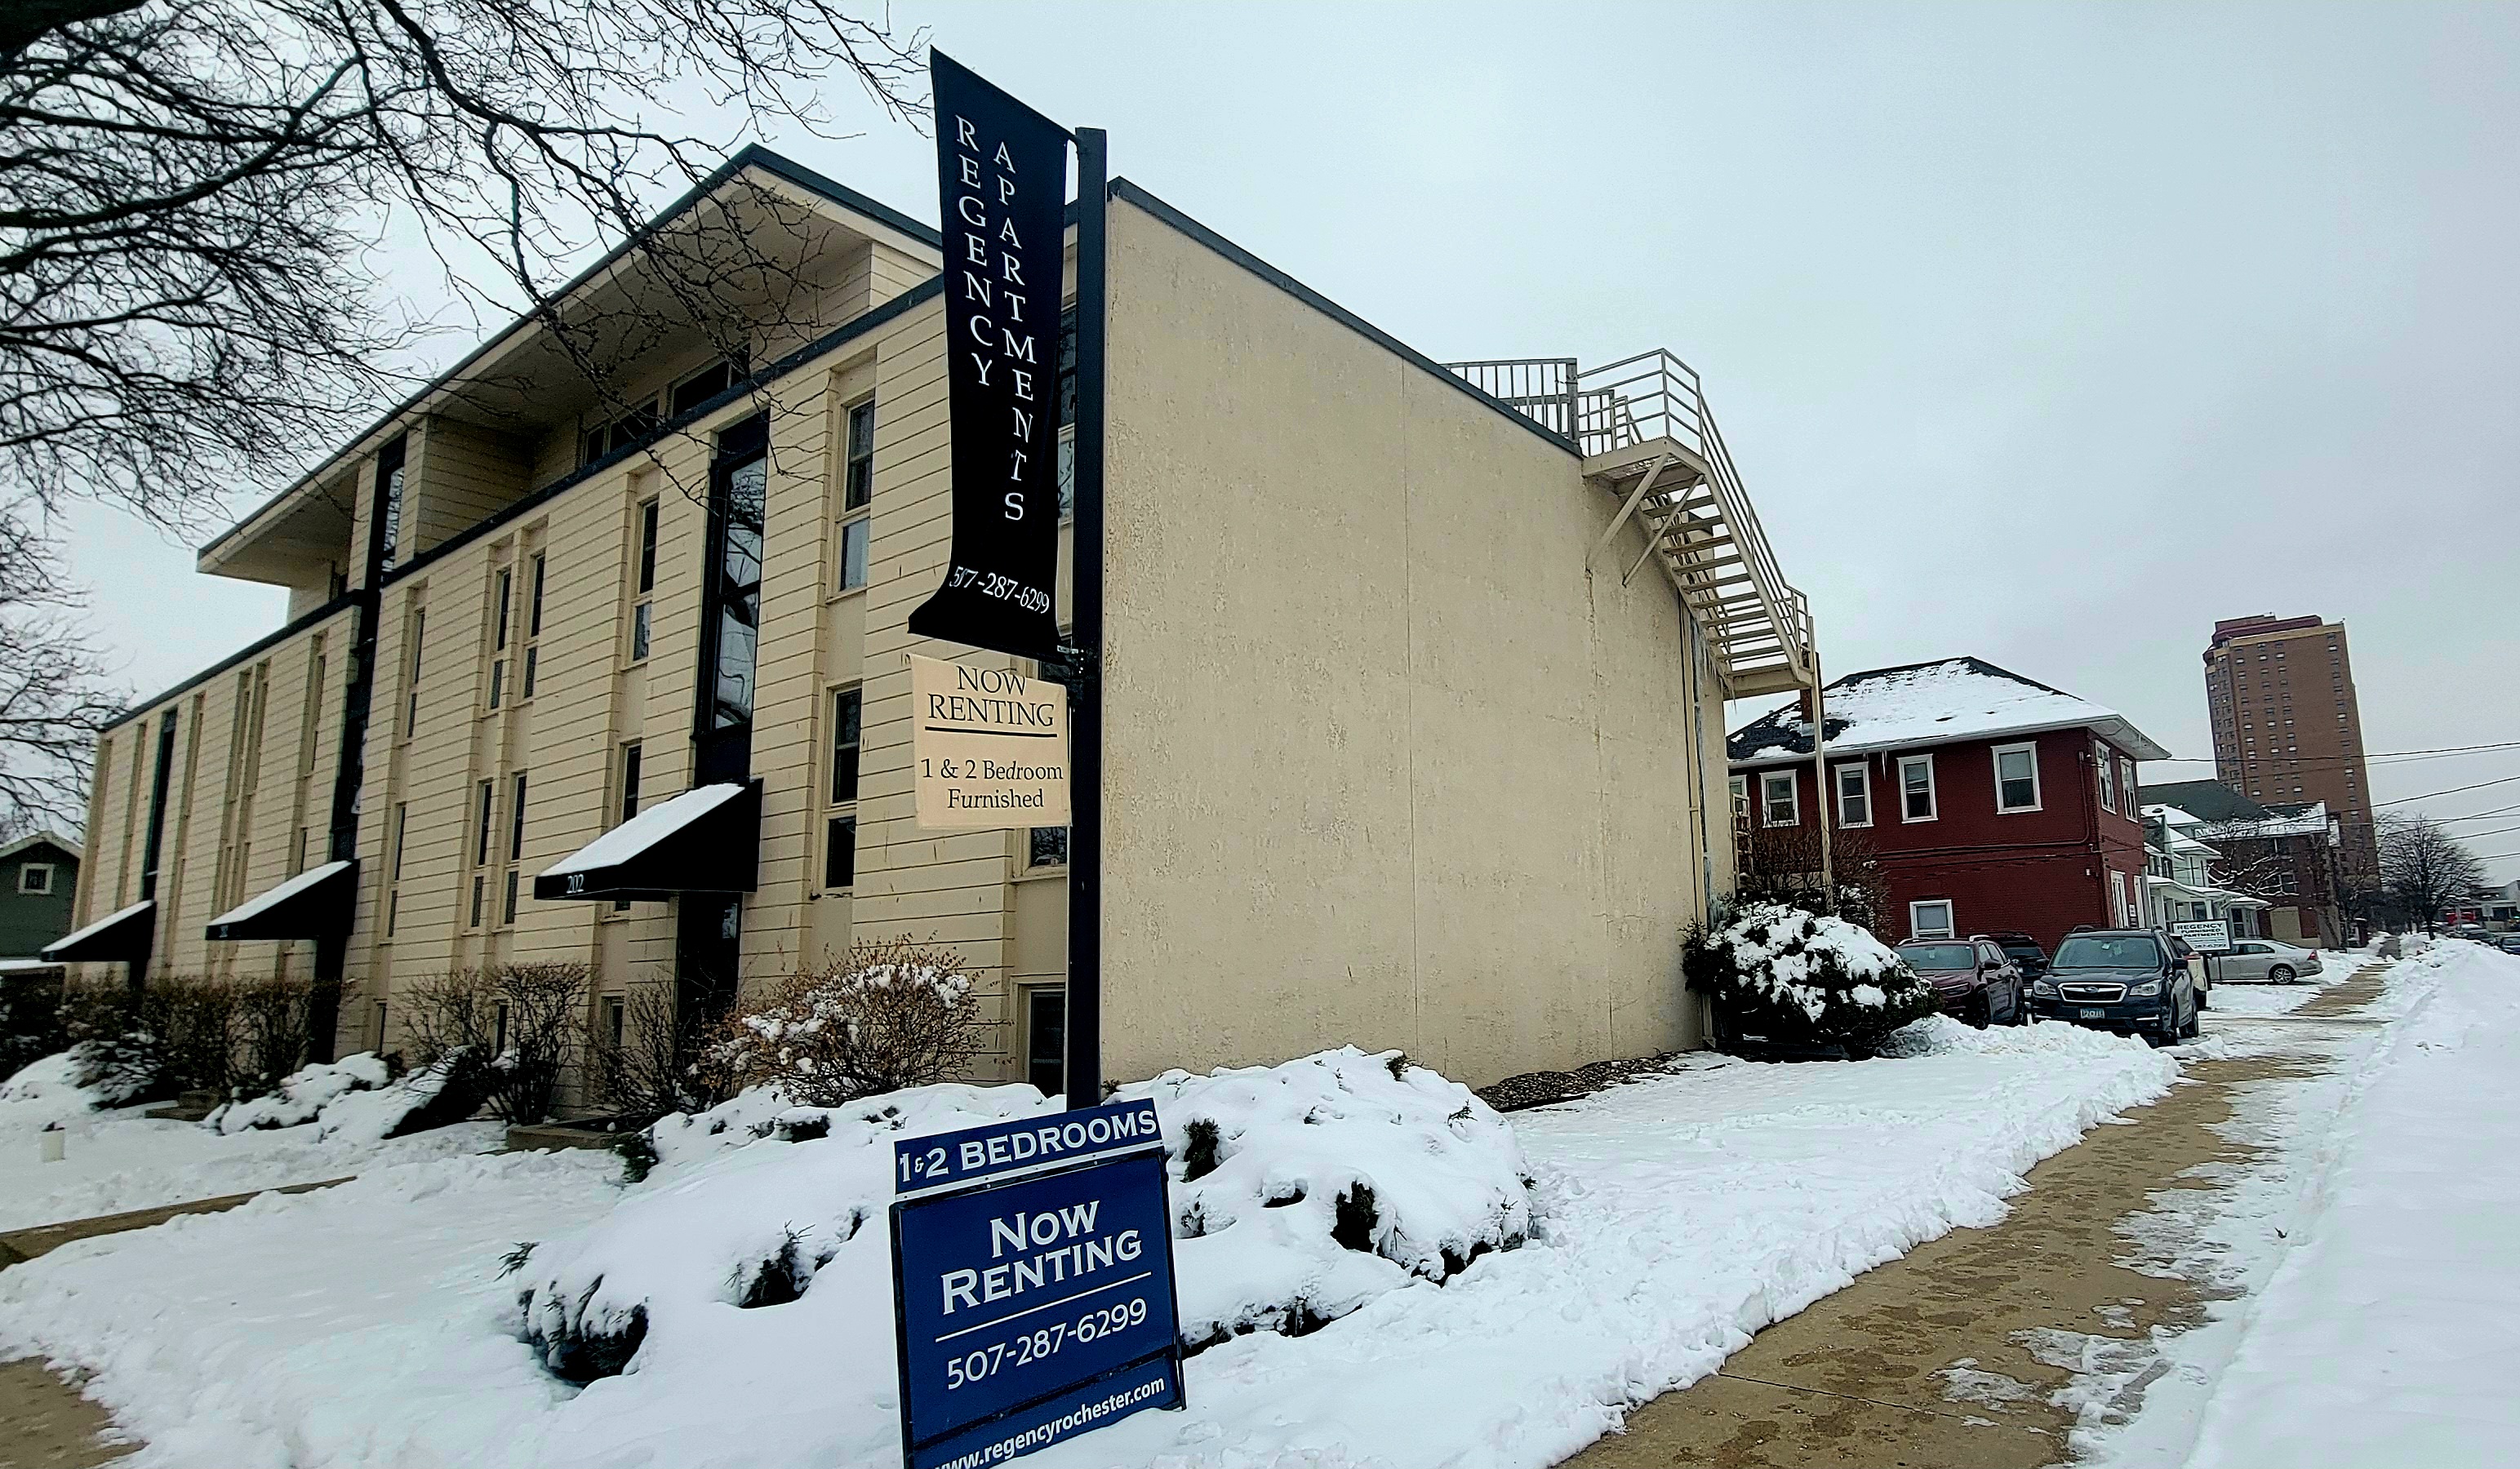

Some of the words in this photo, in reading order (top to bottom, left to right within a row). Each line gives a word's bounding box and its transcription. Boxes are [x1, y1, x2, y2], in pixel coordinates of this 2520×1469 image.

[954, 114, 993, 386] REGENCY
[993, 141, 1037, 521] APARTMENTS
[956, 665, 1026, 695] NOW
[927, 693, 1055, 726] RENTING
[921, 758, 933, 778] 1
[940, 758, 958, 778] &
[965, 759, 977, 779] 2
[982, 760, 1064, 780] Bedroom
[947, 788, 1044, 809] Furnished
[566, 873, 584, 894] 202
[958, 1110, 1158, 1171] BEDROOMS
[947, 1298, 1147, 1391] 507-287-6299
[934, 1376, 1165, 1469] ww.regencyrochester.com
